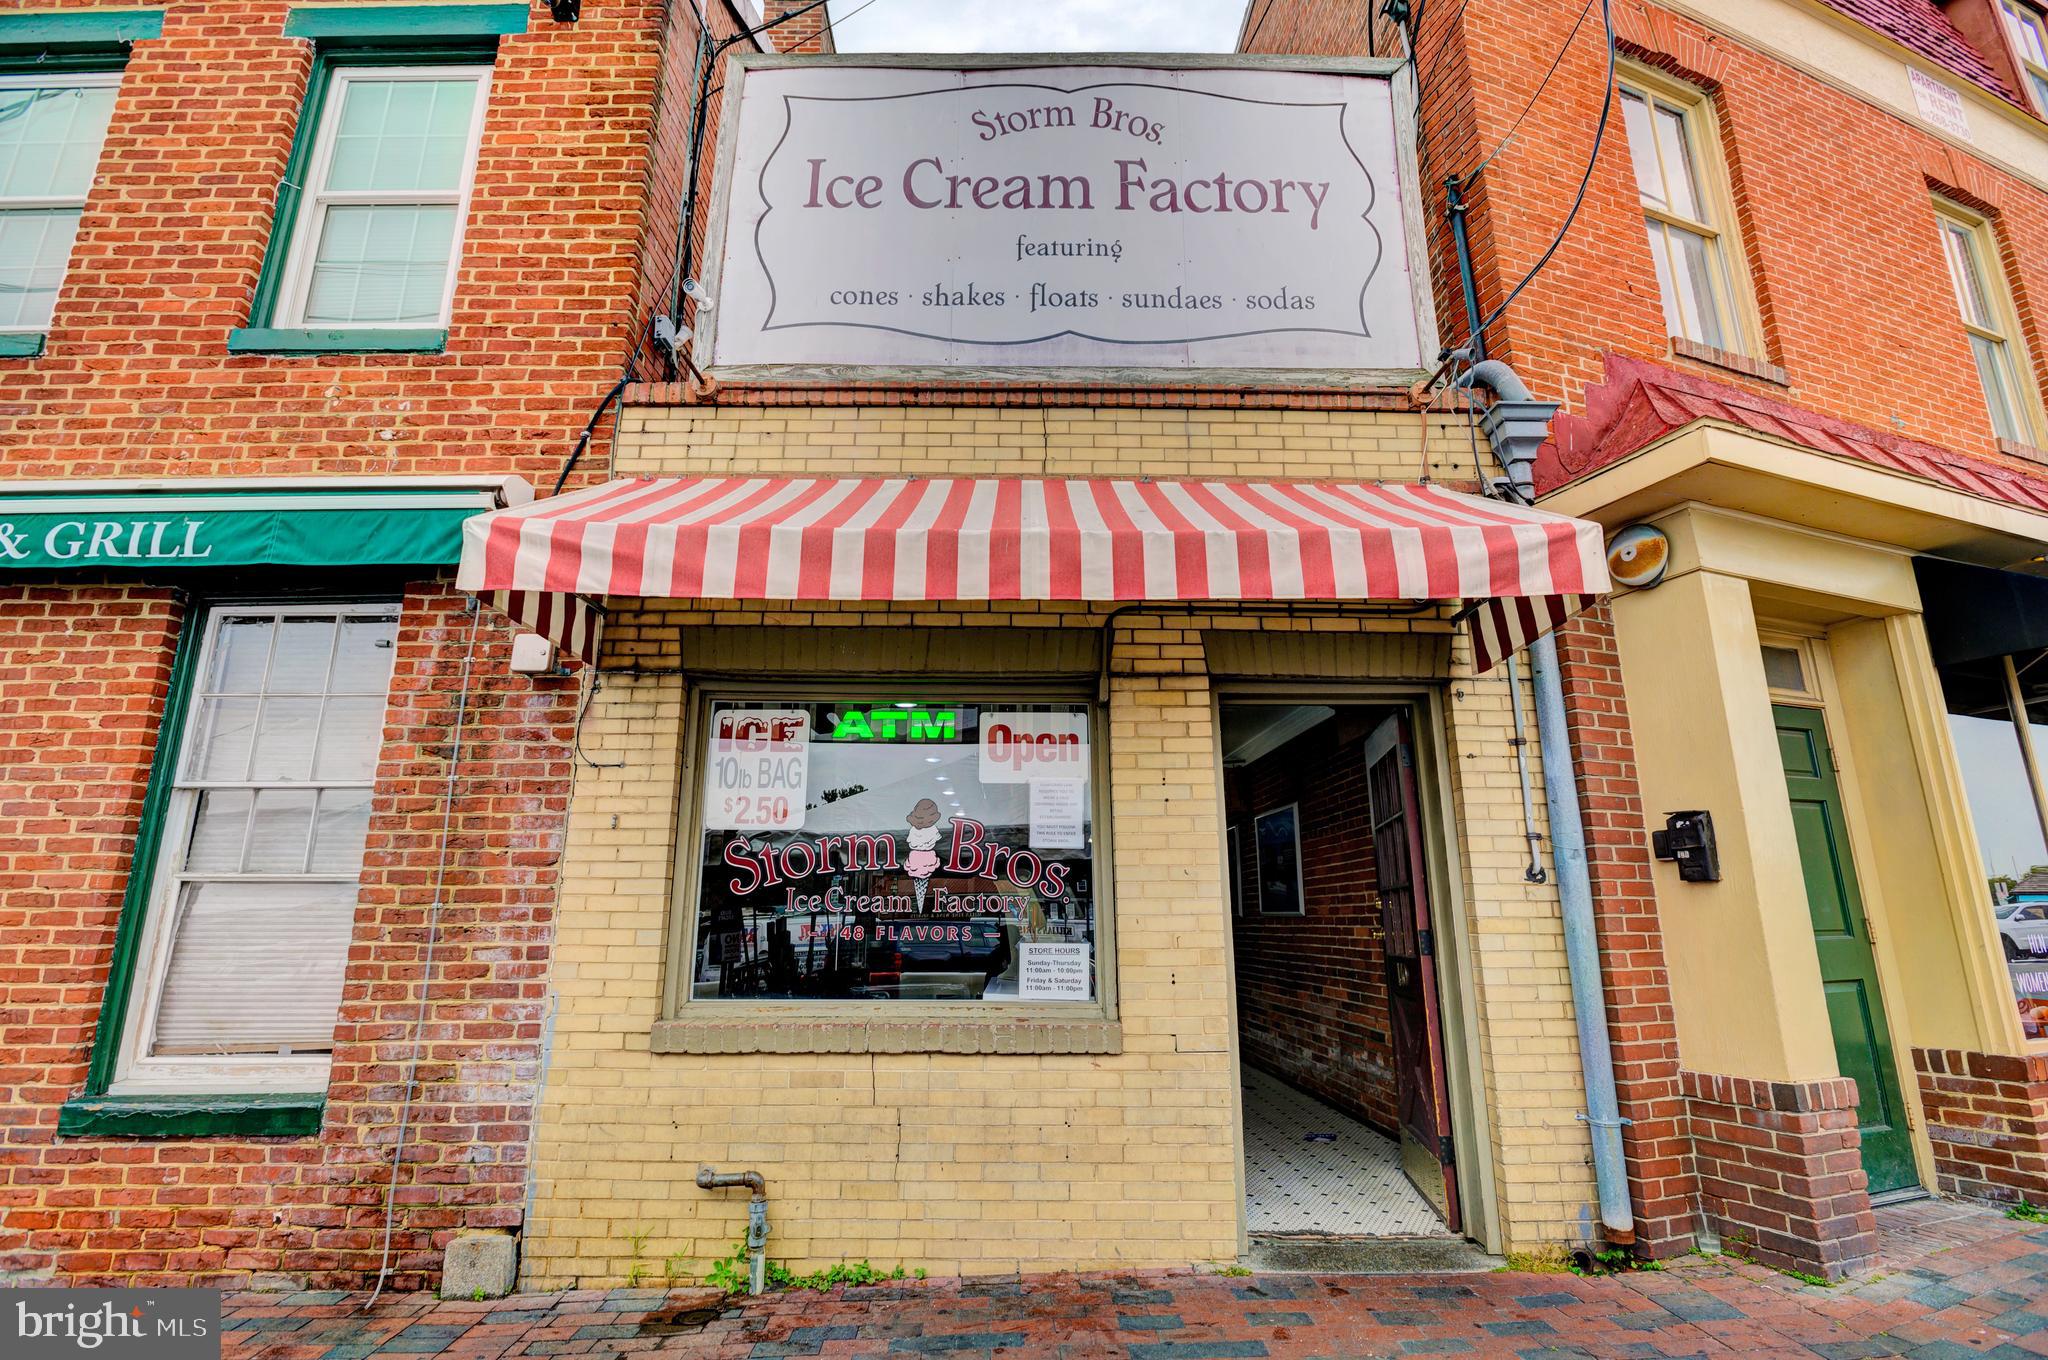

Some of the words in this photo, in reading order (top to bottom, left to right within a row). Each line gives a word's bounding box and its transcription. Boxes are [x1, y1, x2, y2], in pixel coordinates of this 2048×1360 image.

[971, 103, 1076, 141] Storm
[1089, 96, 1166, 145] Bros.
[1928, 92, 1964, 122] RENT
[803, 158, 883, 209] Ice
[902, 156, 1095, 209] Cream
[1114, 157, 1330, 230] Factory
[1016, 234, 1122, 263] featuring
[830, 288, 899, 306] cones
[922, 281, 1005, 307] shakes
[1029, 282, 1098, 313] floats
[1121, 285, 1222, 309] sundaes
[1246, 285, 1316, 310] sodas
[0, 523, 30, 559] &
[44, 521, 212, 559] GRILL
[719, 716, 804, 753] ICE
[832, 710, 955, 739] ATM
[987, 723, 1079, 771] Open
[757, 757, 802, 789] BAG
[723, 796, 789, 824] $2.50
[723, 833, 900, 895] Storm
[943, 816, 1071, 904] Bros.
[784, 886, 822, 913] Ice
[824, 886, 912, 913] Cream
[932, 886, 1031, 920] Factory
[839, 925, 865, 941] 48
[875, 925, 973, 941] FLAVORS
[1028, 947, 1053, 955] STORE
[1054, 947, 1081, 955] HOURS
[1054, 977, 1082, 985] Saturday
